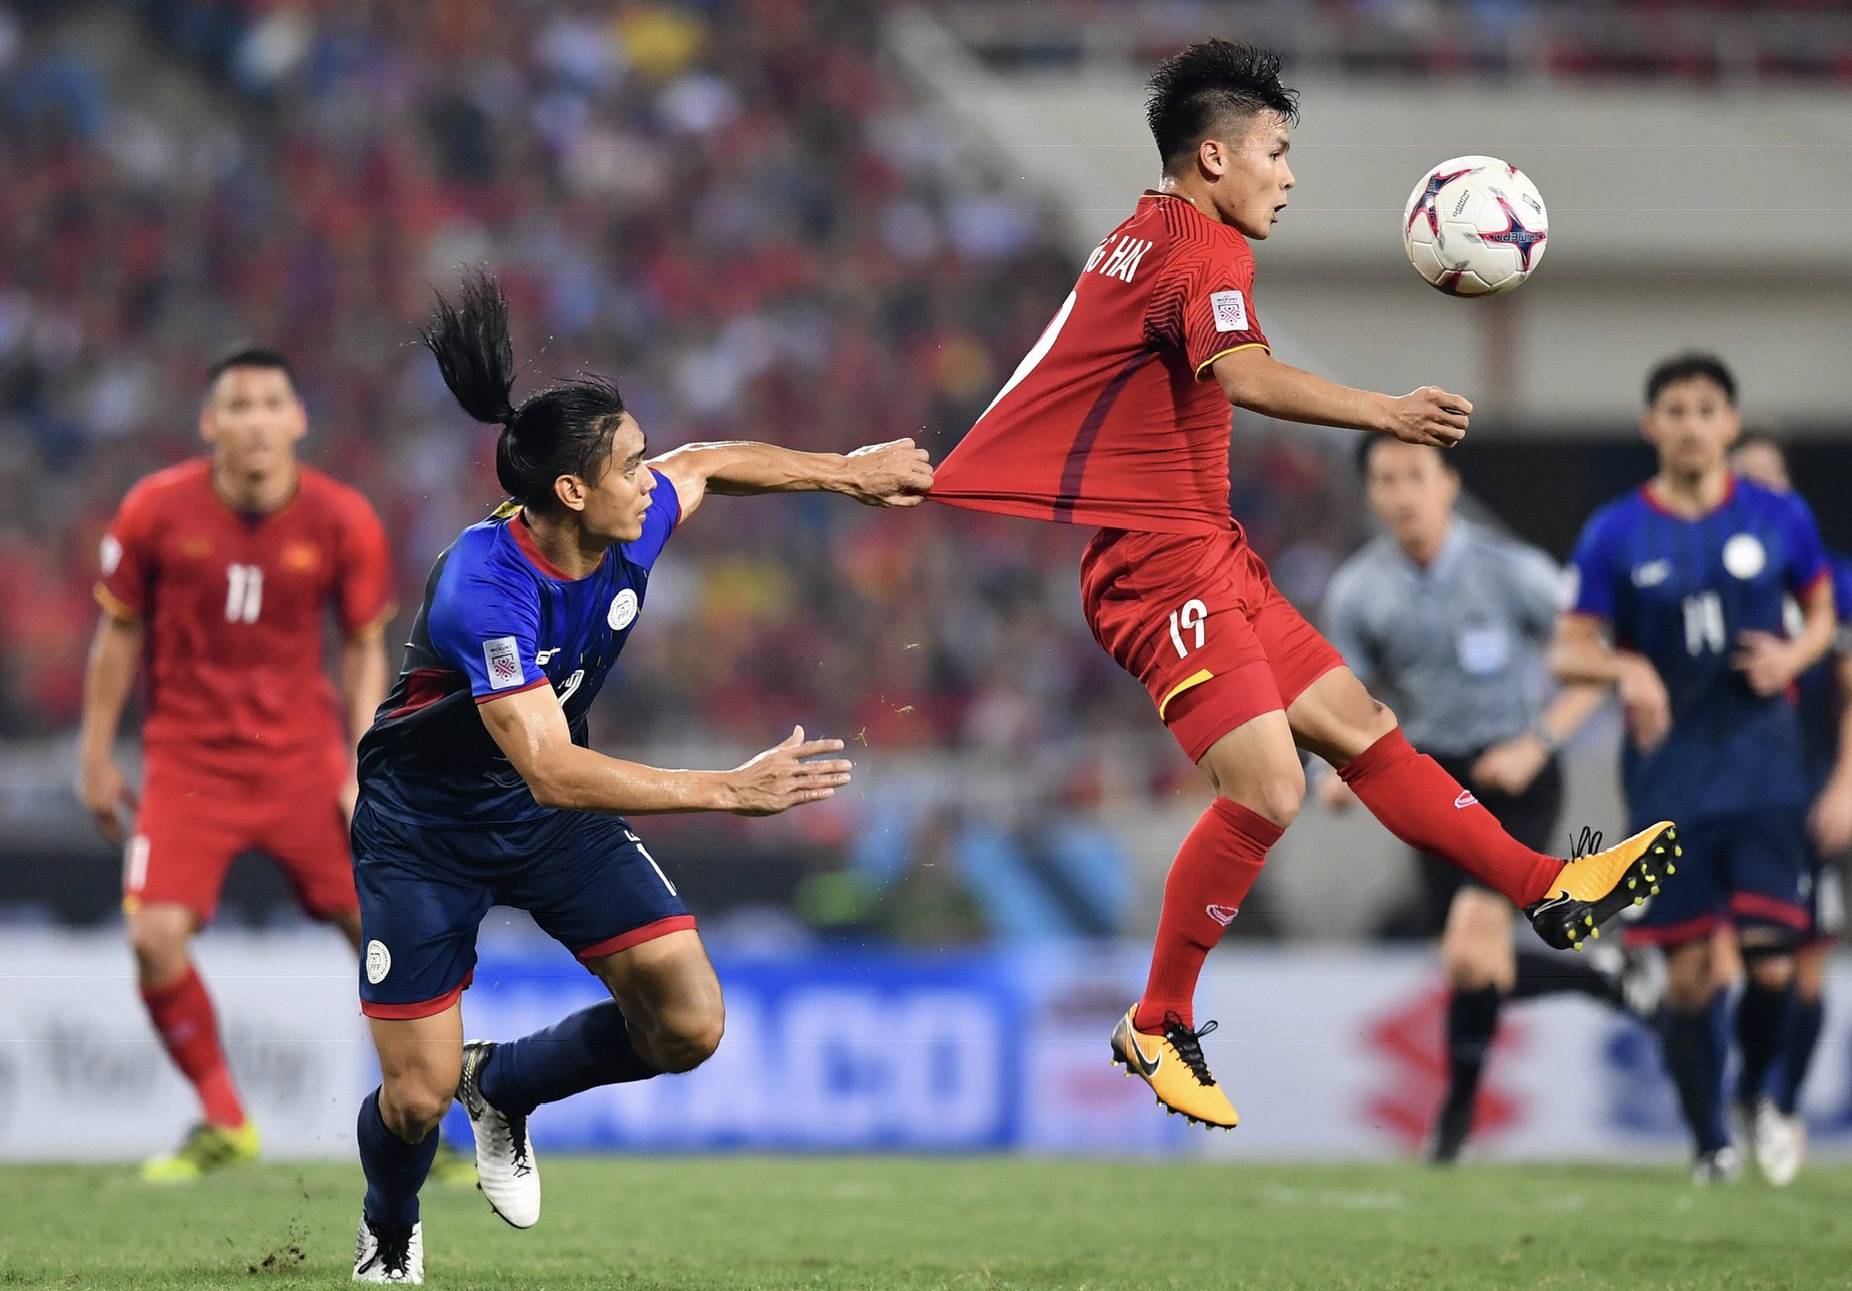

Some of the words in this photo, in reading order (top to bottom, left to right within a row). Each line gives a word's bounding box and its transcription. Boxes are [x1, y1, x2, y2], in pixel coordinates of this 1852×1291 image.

[1099, 235, 1154, 284] HAI
[225, 563, 263, 624] 11
[1169, 599, 1208, 660] 19
